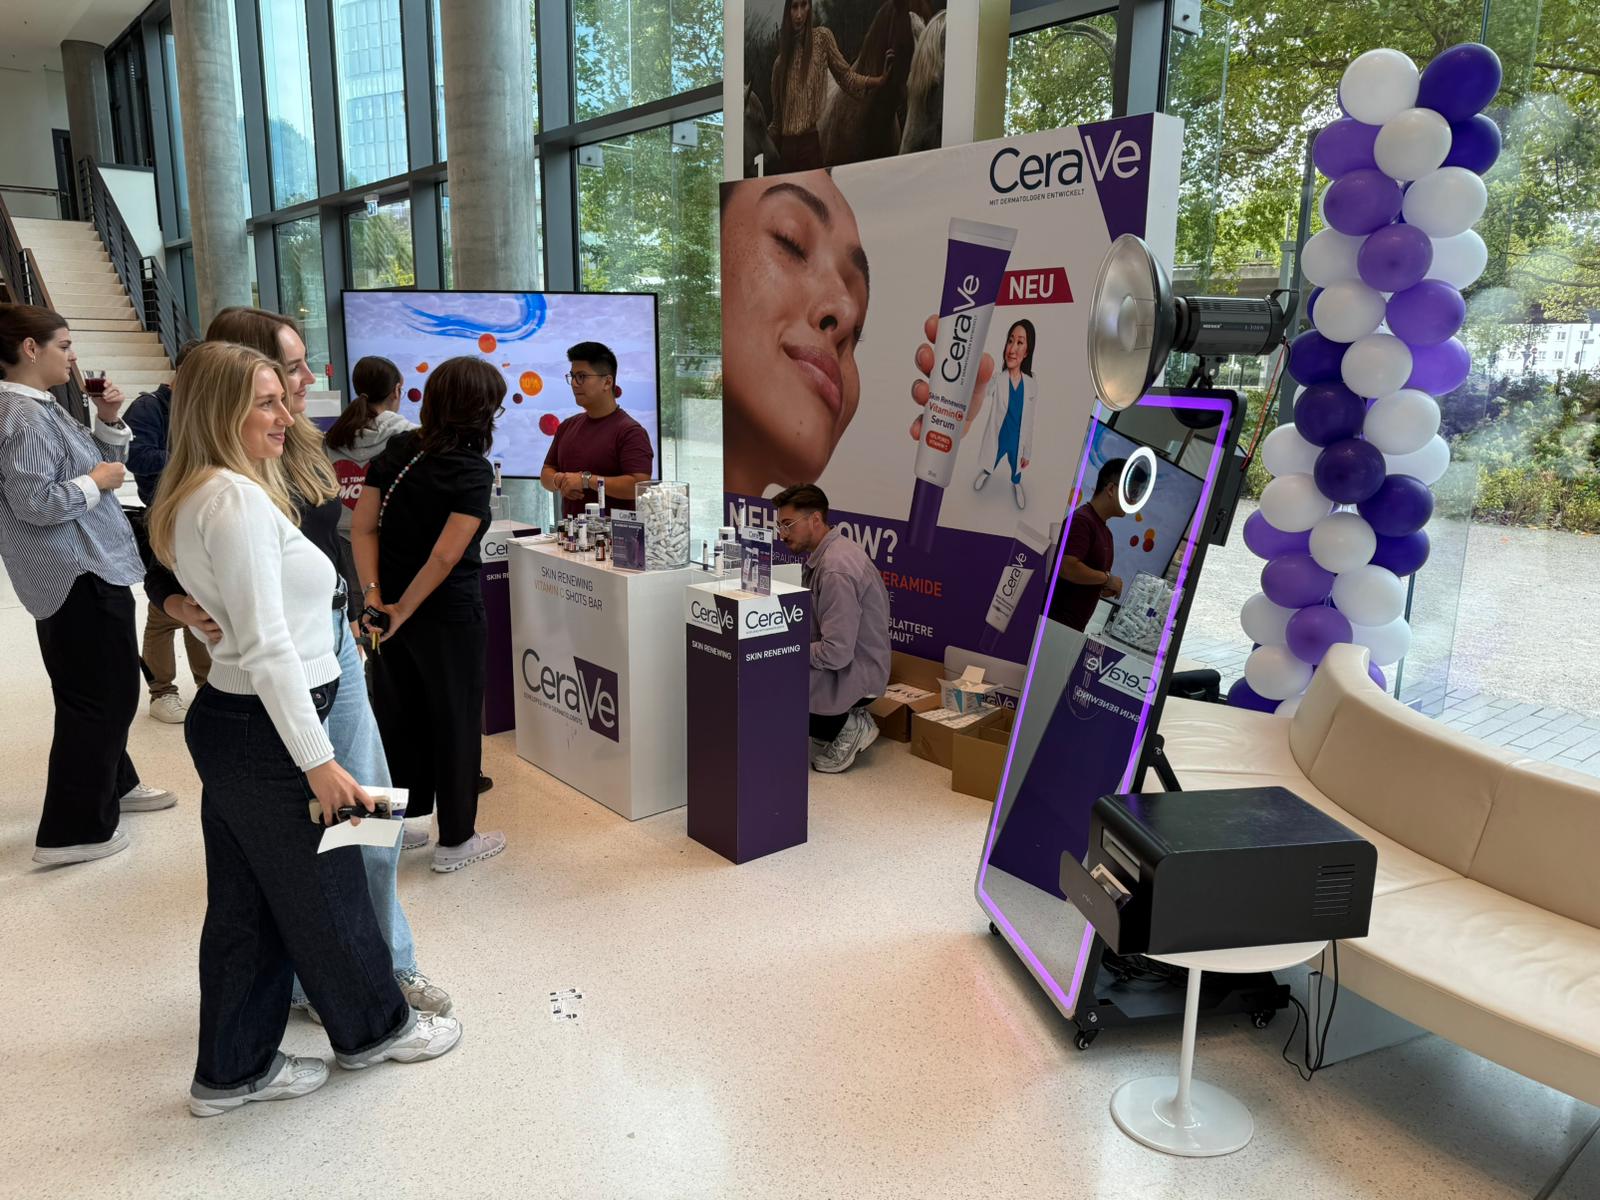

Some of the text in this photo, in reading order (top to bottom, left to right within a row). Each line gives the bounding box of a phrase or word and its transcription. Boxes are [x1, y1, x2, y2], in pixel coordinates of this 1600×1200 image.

[754, 153, 764, 178] 1
[989, 129, 1142, 194] CeraVe
[989, 188, 1085, 206] MIT DERMATOLOGEN ENTWICKELT
[1008, 273, 1055, 300] NEU
[941, 274, 980, 383] CeraVe
[928, 391, 967, 412] Skin Renewing
[929, 402, 955, 418] Vitamin
[931, 415, 955, 431] Serum
[541, 566, 594, 592] SKIN RENEWING
[880, 571, 943, 597] ERAMIDE
[1002, 552, 1027, 597] CeraVe
[535, 580, 559, 597] VITAMIN
[565, 589, 588, 606] SHOTS
[588, 596, 603, 612] BAR
[691, 600, 734, 630] CeraVe
[745, 604, 804, 630] CeraVe
[691, 640, 732, 661] SKIN RENEWING
[745, 644, 801, 662] SKIN RENEWING
[522, 648, 616, 728] CeraVe
